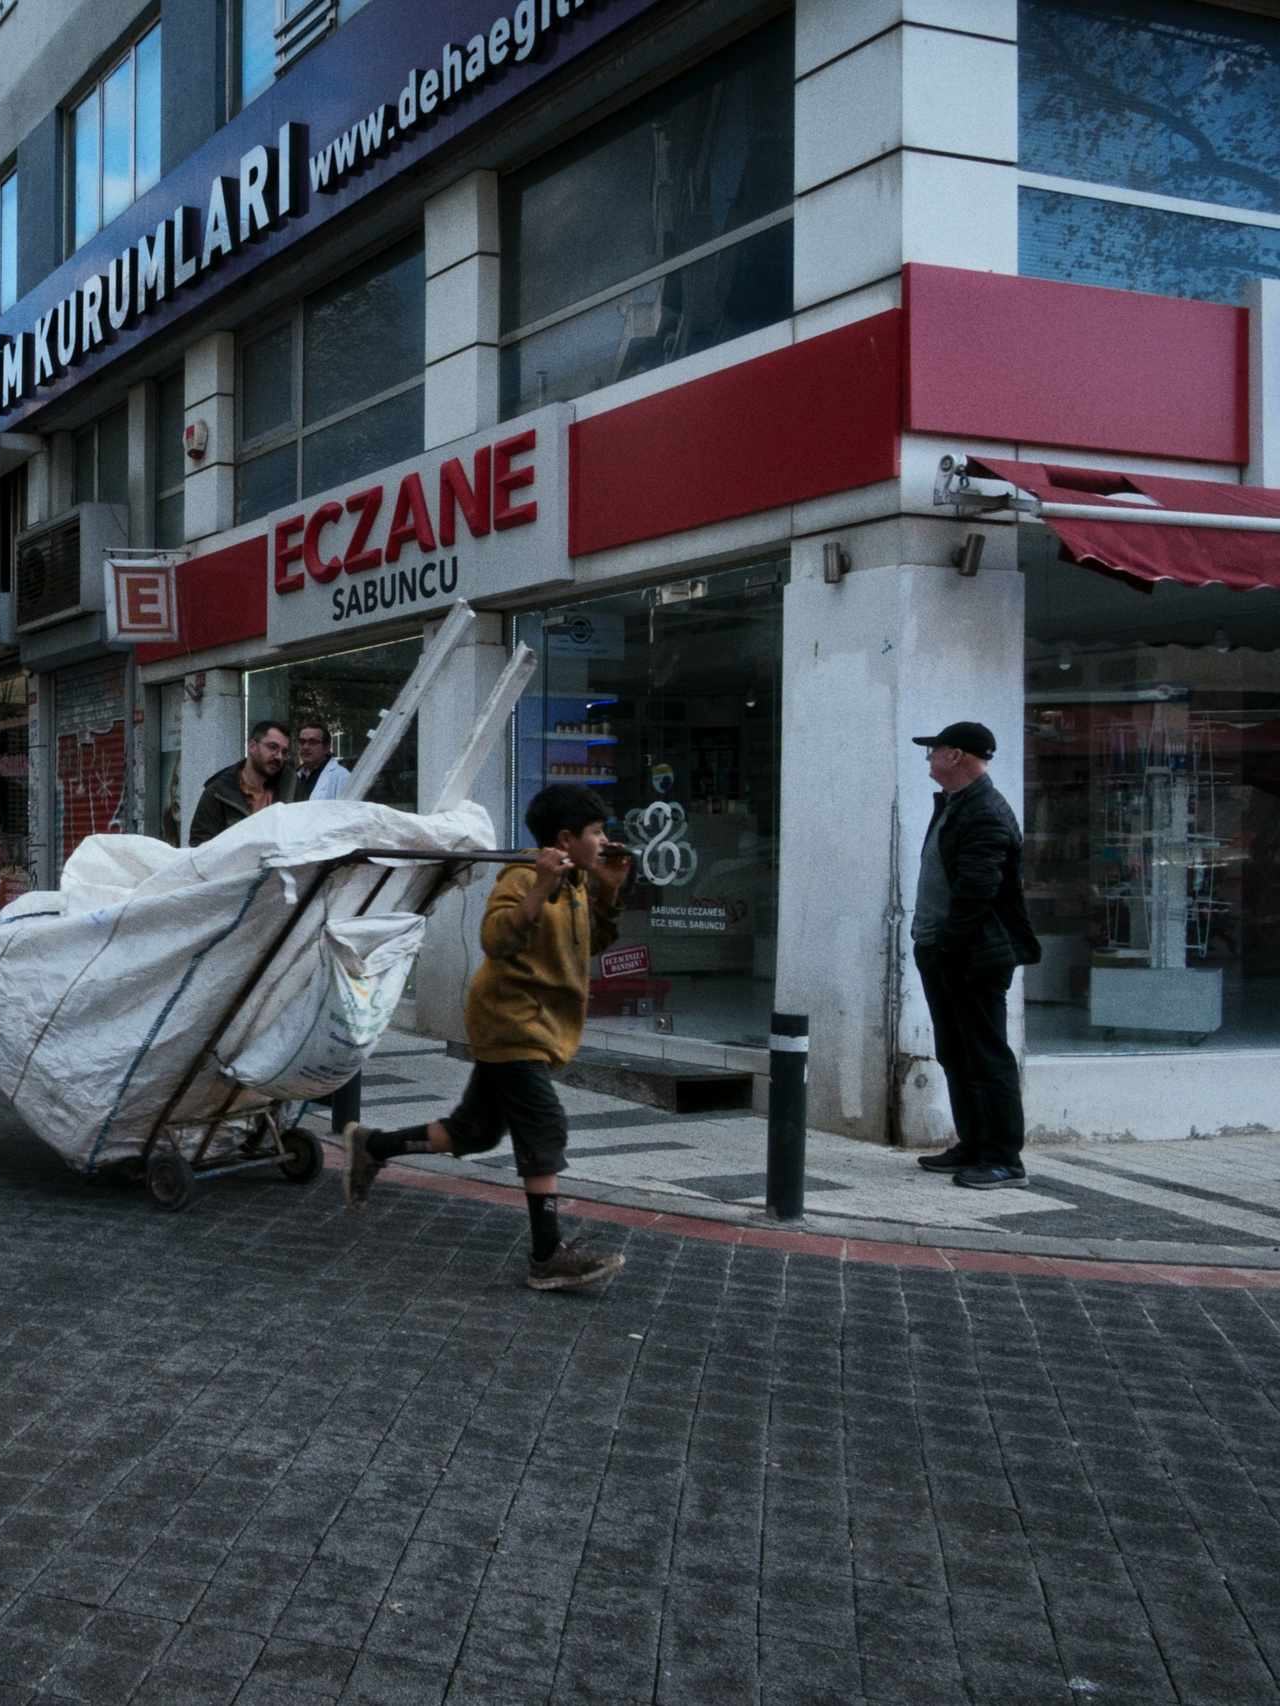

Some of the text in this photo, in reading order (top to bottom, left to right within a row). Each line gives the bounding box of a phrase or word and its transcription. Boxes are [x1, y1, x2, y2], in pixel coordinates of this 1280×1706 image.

[34, 121, 290, 386] KURUMLARI
[308, 0, 584, 193] www.dehaegi
[275, 428, 537, 595] ECZANE
[126, 578, 162, 624] E
[332, 556, 458, 621] SABUNCU
[651, 905, 726, 917] SABUNCU ECZANESİ
[667, 919, 688, 928] EMEL
[689, 920, 726, 931] SABUNCU
